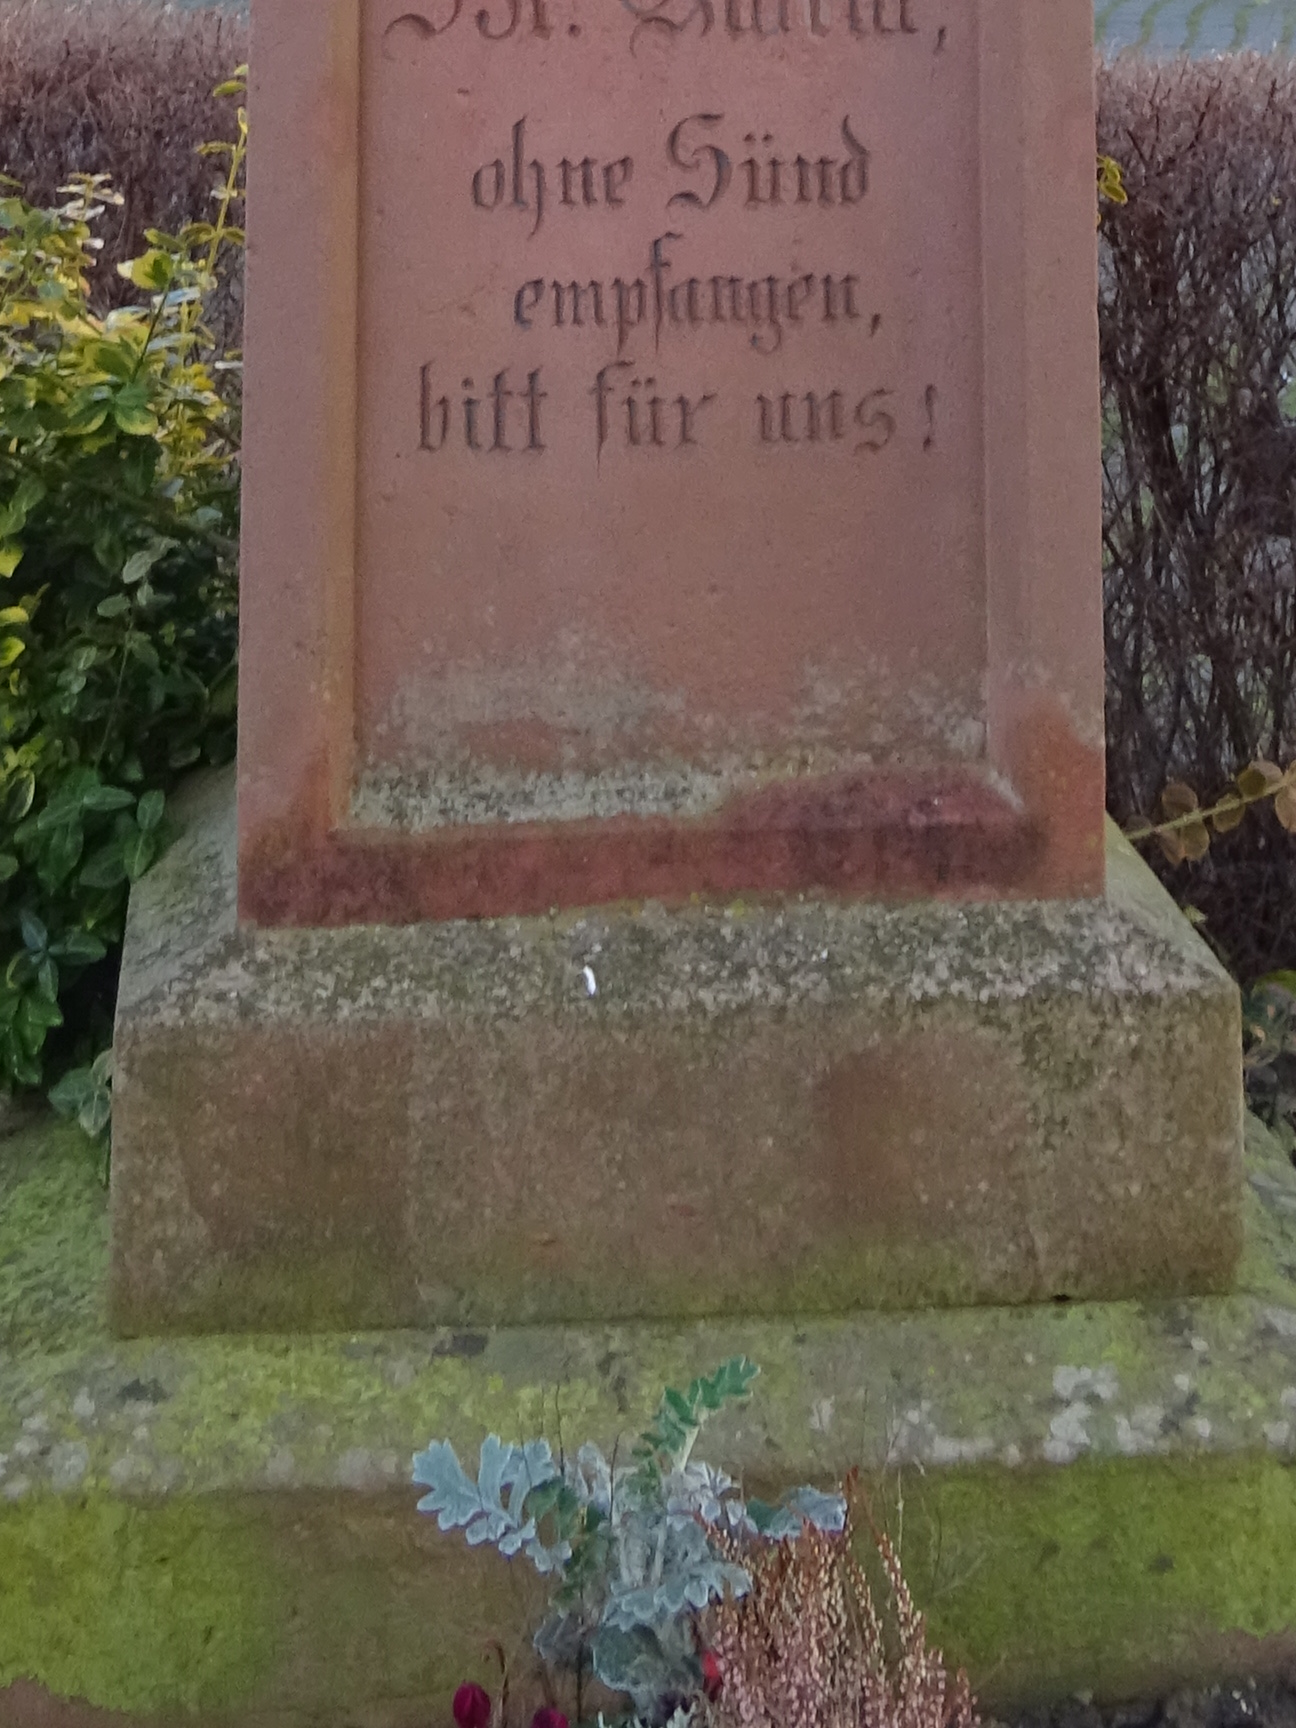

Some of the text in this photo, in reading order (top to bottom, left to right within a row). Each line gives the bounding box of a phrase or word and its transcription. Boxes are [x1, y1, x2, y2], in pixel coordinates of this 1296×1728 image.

[471, 111, 871, 239] ohne Sünd
[512, 231, 882, 355] empfangen,
[417, 359, 549, 453] bitt
[592, 358, 718, 473] für
